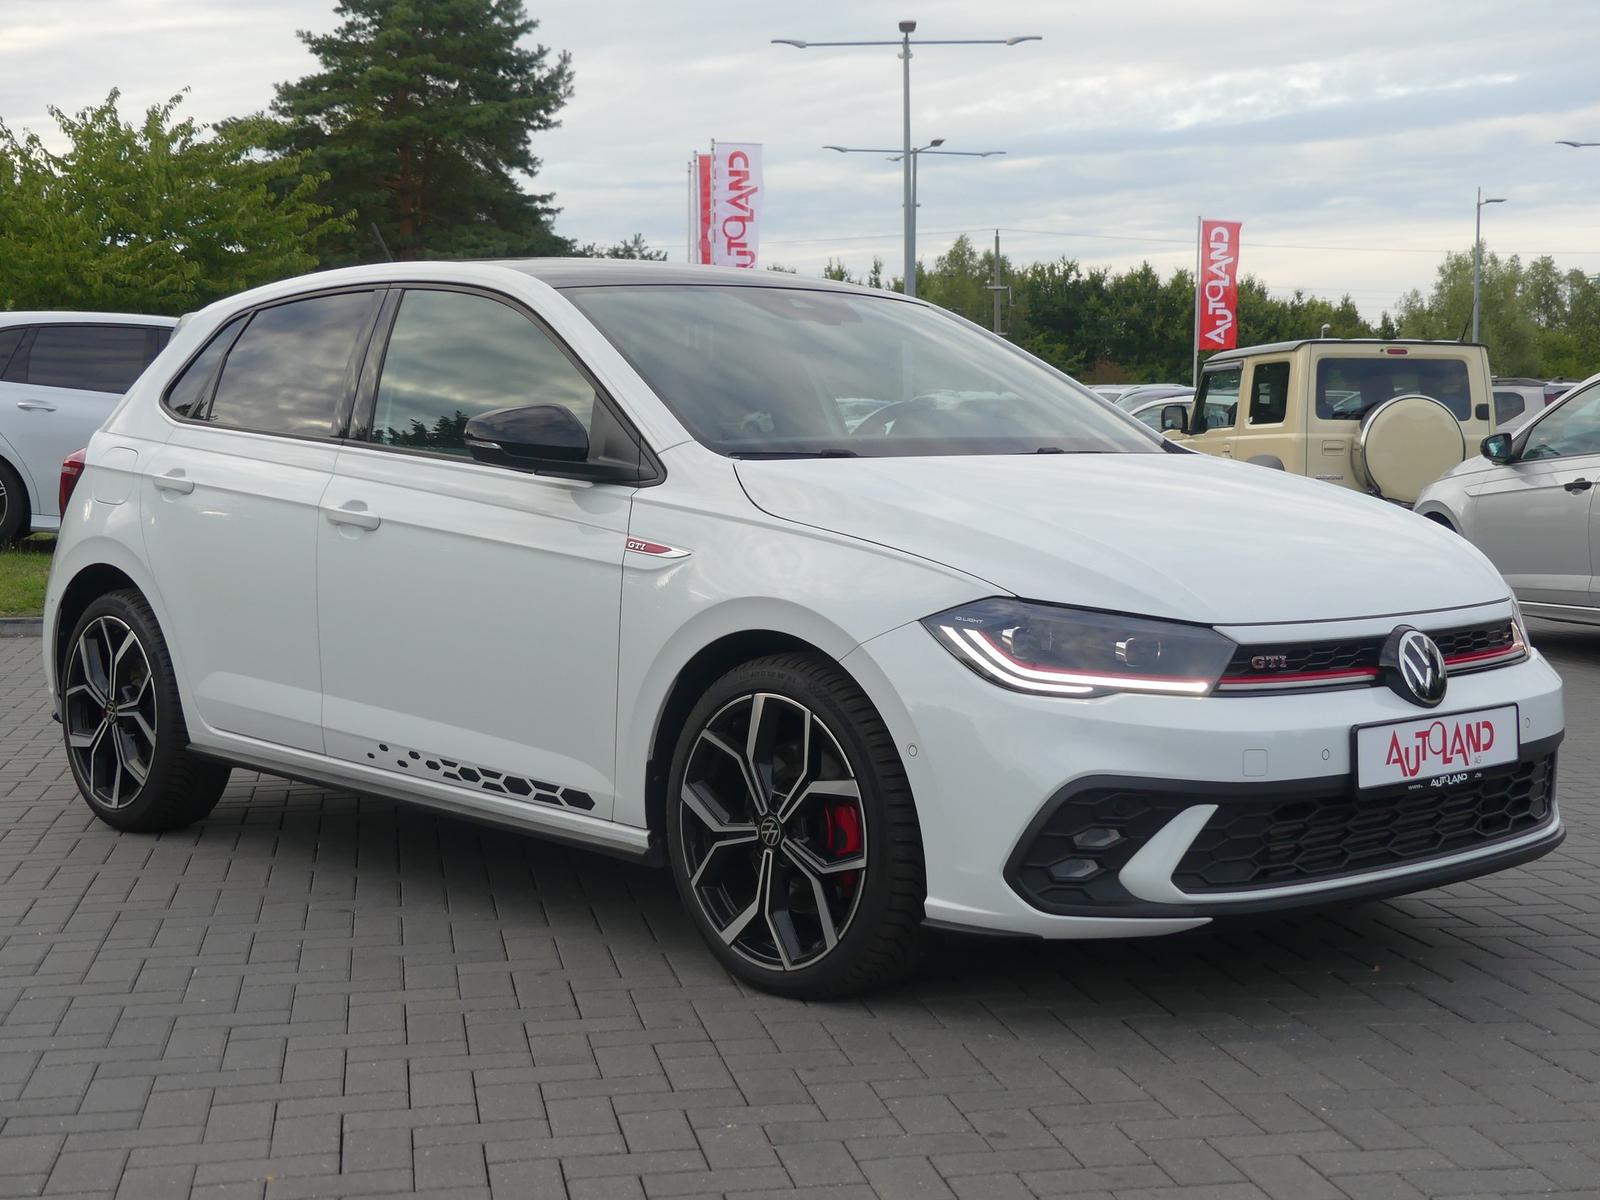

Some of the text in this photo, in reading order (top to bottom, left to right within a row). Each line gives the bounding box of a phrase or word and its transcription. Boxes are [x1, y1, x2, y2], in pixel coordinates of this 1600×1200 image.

[722, 151, 758, 268] UTOLAND
[1205, 226, 1233, 344] AUTOLAND
[628, 541, 646, 550] GTI
[1251, 656, 1287, 669] GTI
[1385, 721, 1494, 776] AUTOLAND
[1430, 773, 1468, 787] AUTOLAND
